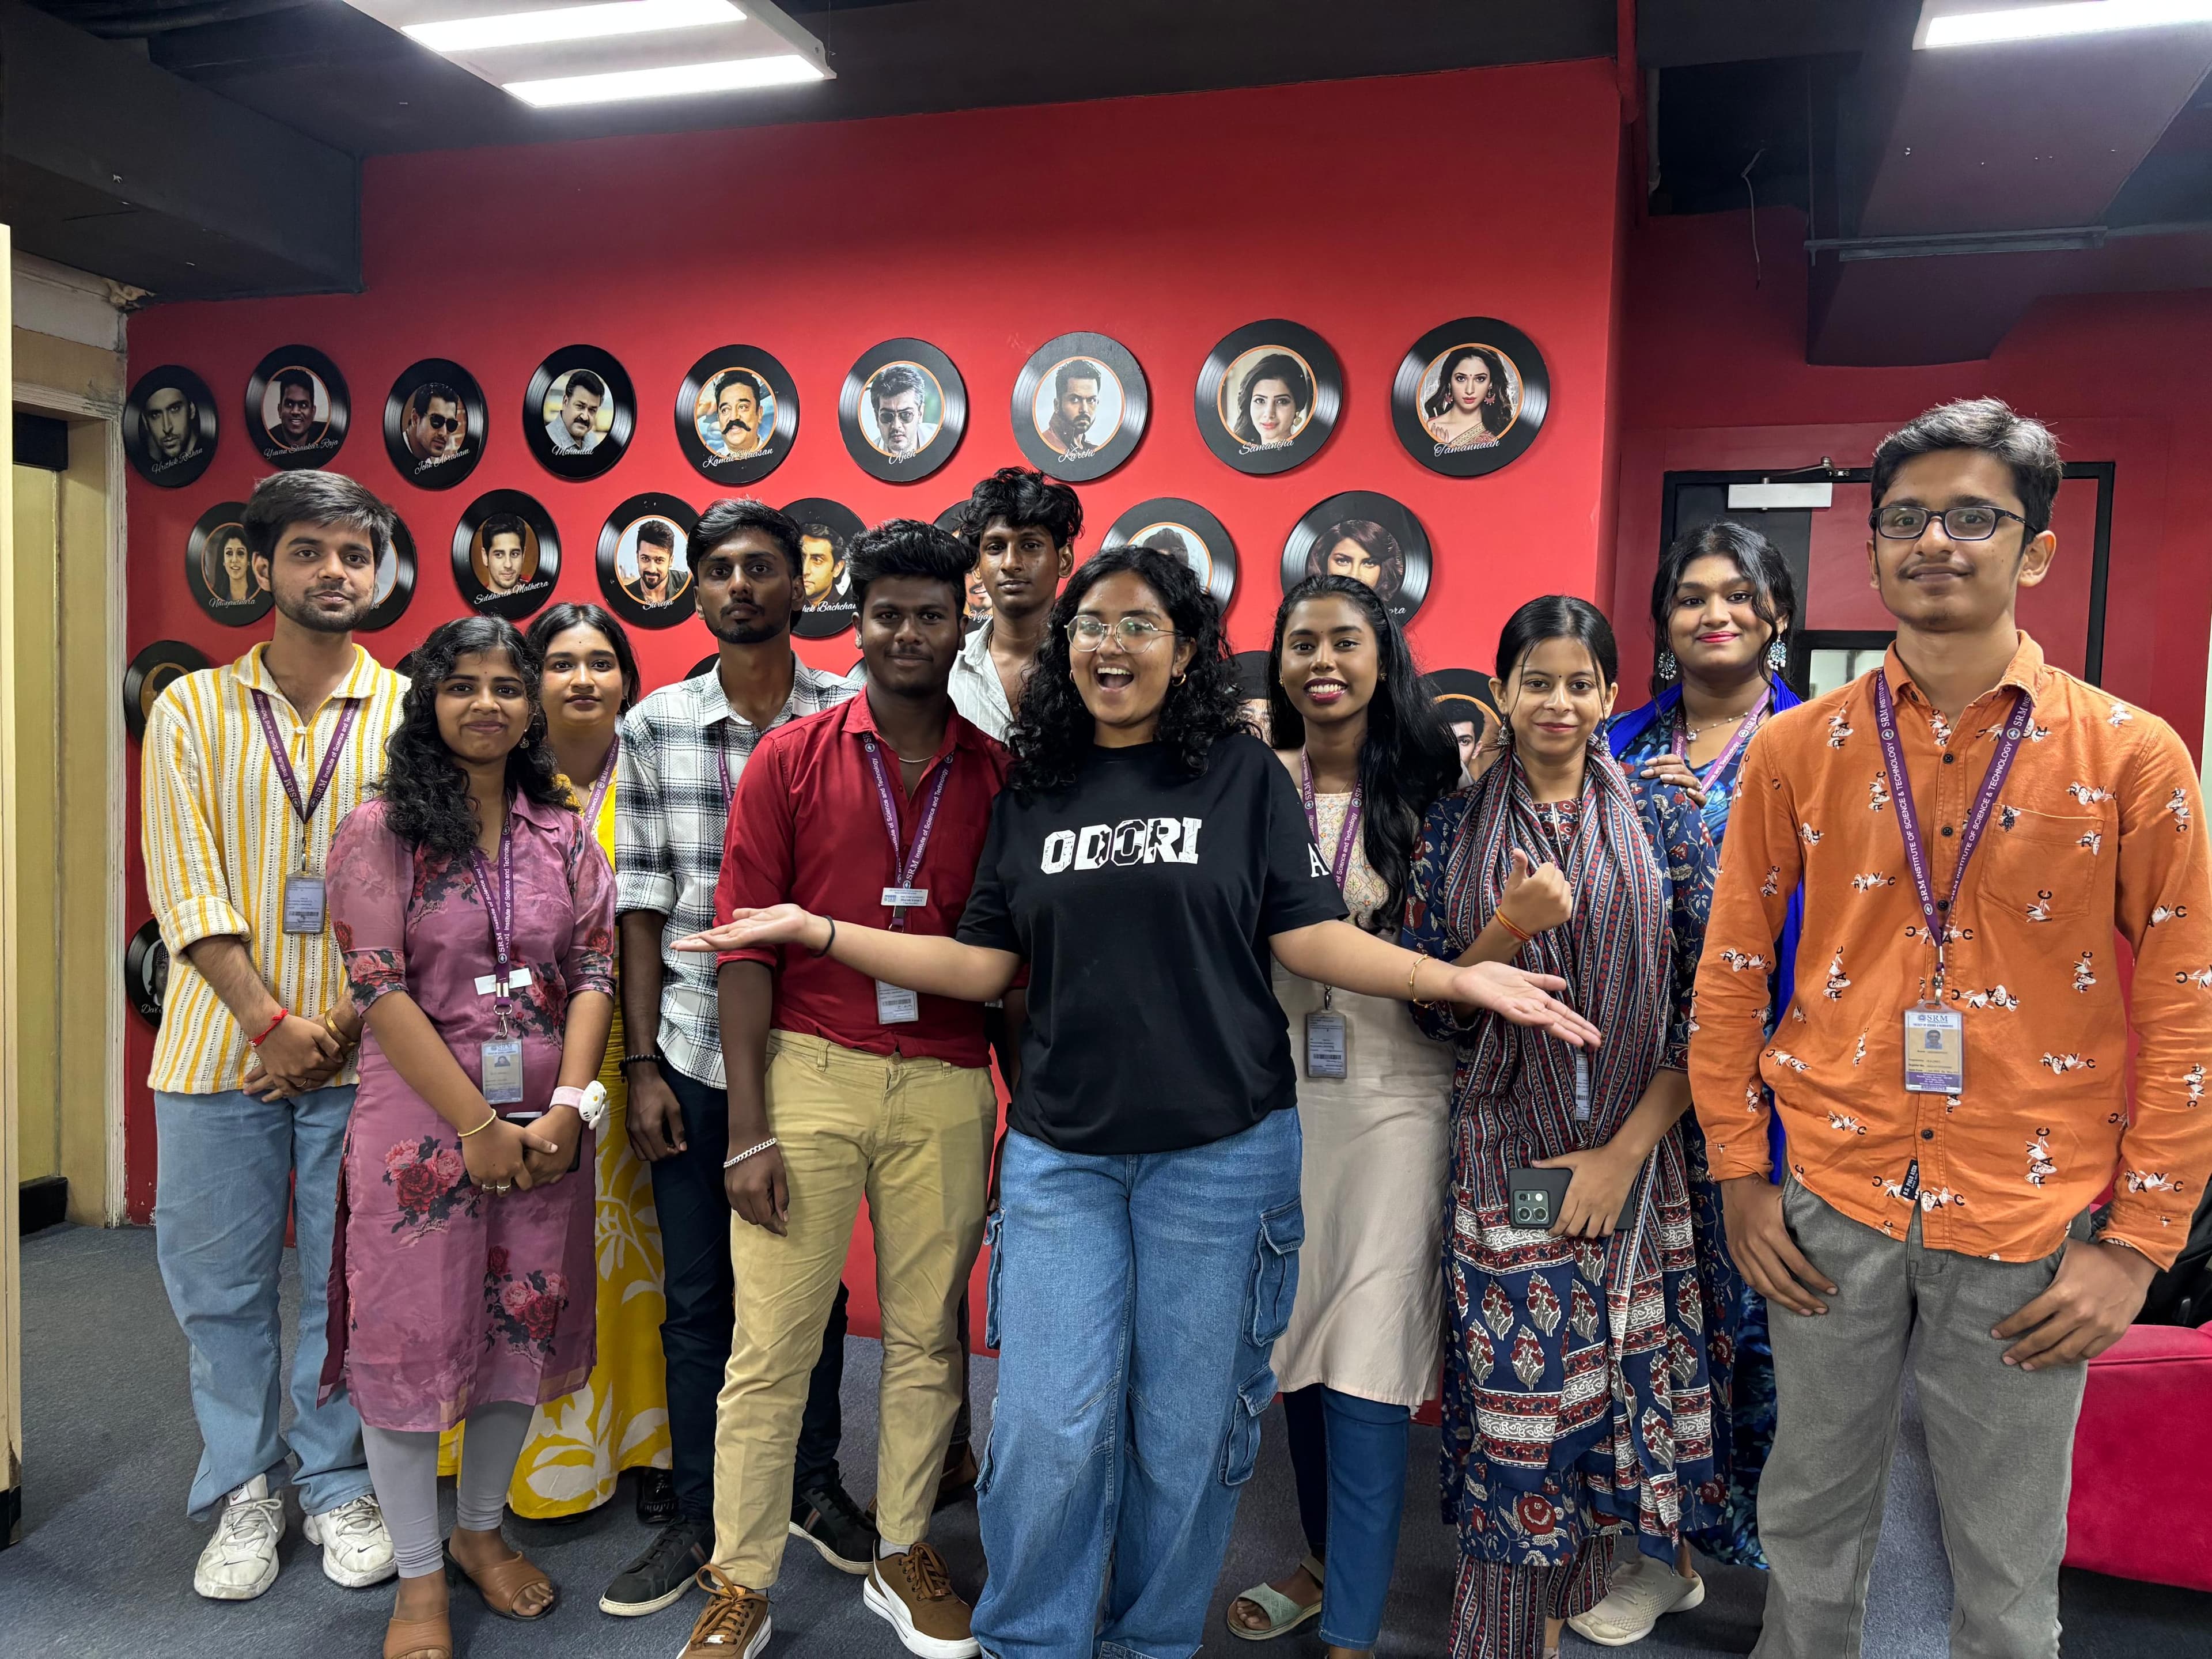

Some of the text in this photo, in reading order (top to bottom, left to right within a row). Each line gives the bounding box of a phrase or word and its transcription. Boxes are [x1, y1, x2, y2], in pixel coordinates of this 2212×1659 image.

[264, 438, 338, 460] Yuvan Shankar Raja
[552, 445, 594, 456] Mohanlal
[889, 449, 916, 465] Ajith
[1058, 446, 1095, 463] Karthi
[1238, 438, 1294, 455] Samantha
[1434, 438, 1501, 457] Tamannaah
[151, 457, 178, 475] Hrithik
[415, 449, 470, 475] John Abraham
[703, 447, 774, 468] Kamal Haasan
[474, 581, 549, 604] Siddharth Malhotra
[642, 599, 674, 610] Suriya
[264, 720, 272, 730] and
[1880, 710, 1890, 727] SRM
[2013, 706, 2028, 727] SRM
[269, 730, 279, 750] Science
[315, 778, 328, 798] SRM
[323, 757, 335, 778] Institute
[332, 732, 344, 752] Science
[871, 758, 884, 789] Technology
[1714, 764, 1724, 775] and
[1887, 742, 1904, 790] TECHNOLOGY
[1988, 741, 2013, 790] TECHNOLOGY
[283, 778, 297, 797] SRM
[1304, 782, 1312, 801] SRM
[883, 800, 892, 822] Science
[1899, 797, 1912, 830] SCIENCE
[1972, 797, 1990, 830] SCIENCE
[906, 859, 919, 880] SRM
[915, 836, 926, 859] Institute
[924, 808, 935, 830] Science
[934, 768, 949, 796] Technology
[1040, 817, 1202, 874] ODORI
[1337, 853, 1347, 875] Science
[1344, 813, 1358, 842] Technology
[1906, 831, 1915, 841] OF
[1968, 830, 1977, 842] OF
[1909, 842, 1922, 878] INSTITUTE
[1956, 842, 1972, 879] INSTITUTE
[480, 880, 491, 901] Science
[1917, 878, 1930, 902] SRM
[491, 908, 500, 930] Institute
[496, 933, 506, 953] SRM
